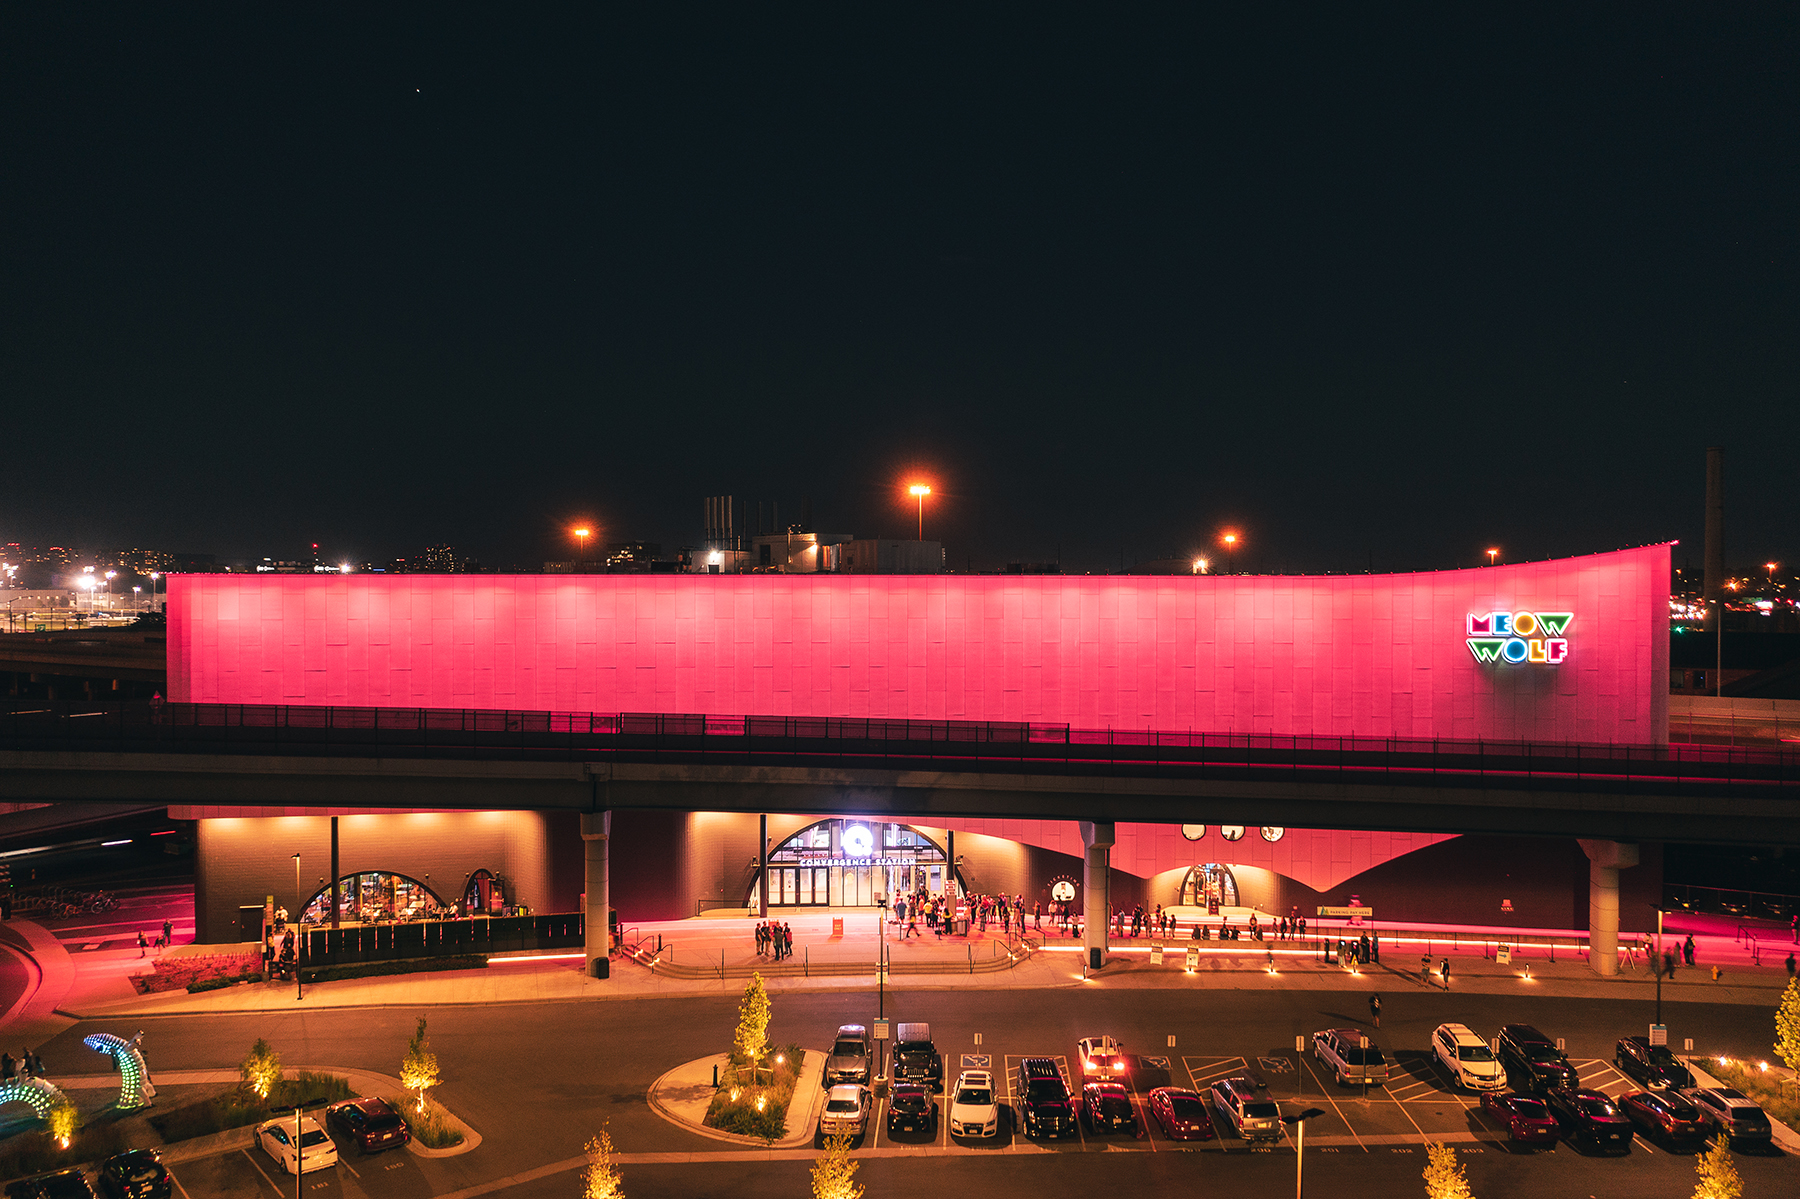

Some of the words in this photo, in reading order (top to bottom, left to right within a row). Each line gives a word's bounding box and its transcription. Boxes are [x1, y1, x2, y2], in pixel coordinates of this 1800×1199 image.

[1466, 611, 1574, 637] MEOW
[1465, 638, 1568, 663] WOLF
[799, 858, 872, 867] CONVERGENCE
[875, 858, 918, 866] STATION
